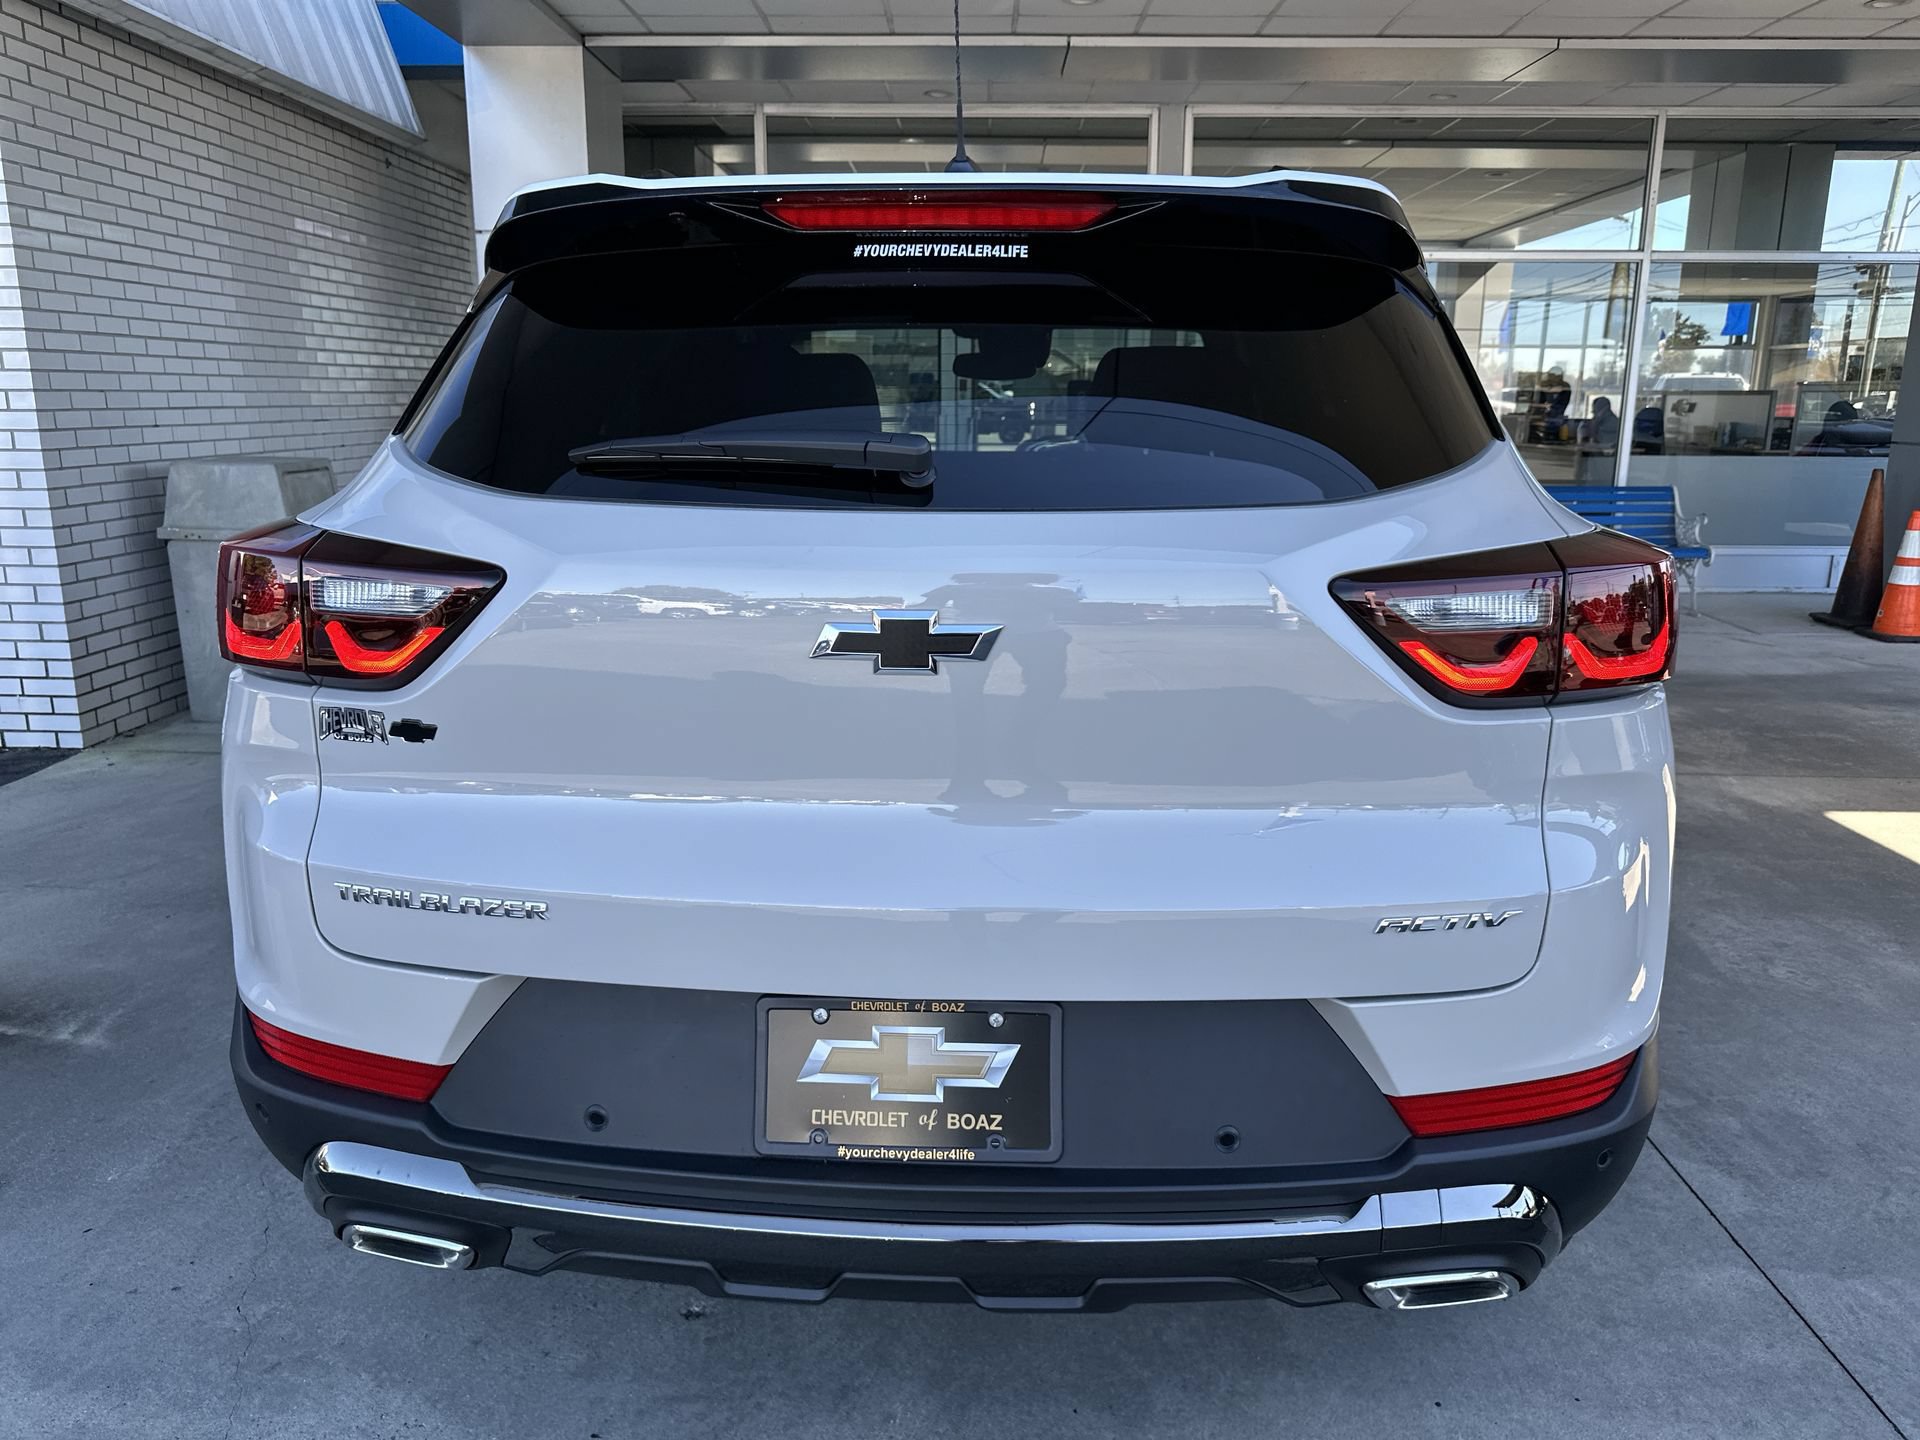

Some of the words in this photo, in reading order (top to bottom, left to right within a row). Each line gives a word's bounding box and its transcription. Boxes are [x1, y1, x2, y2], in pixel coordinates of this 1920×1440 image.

[853, 244, 1028, 258] #YOURCHEVYDEALER4LIFE
[319, 706, 389, 745] CHEVROLET
[334, 882, 549, 920] TRAILBLAZER
[1374, 909, 1524, 934] ACTIV
[851, 1001, 909, 1011] CHEVROLET
[915, 1000, 926, 1013] of
[931, 1002, 965, 1012] BOAZ
[811, 1109, 909, 1128] CHEVROLET
[918, 1108, 939, 1131] of
[947, 1113, 1003, 1131] BOAZ
[837, 1145, 976, 1162] #yourchevydealer4life
